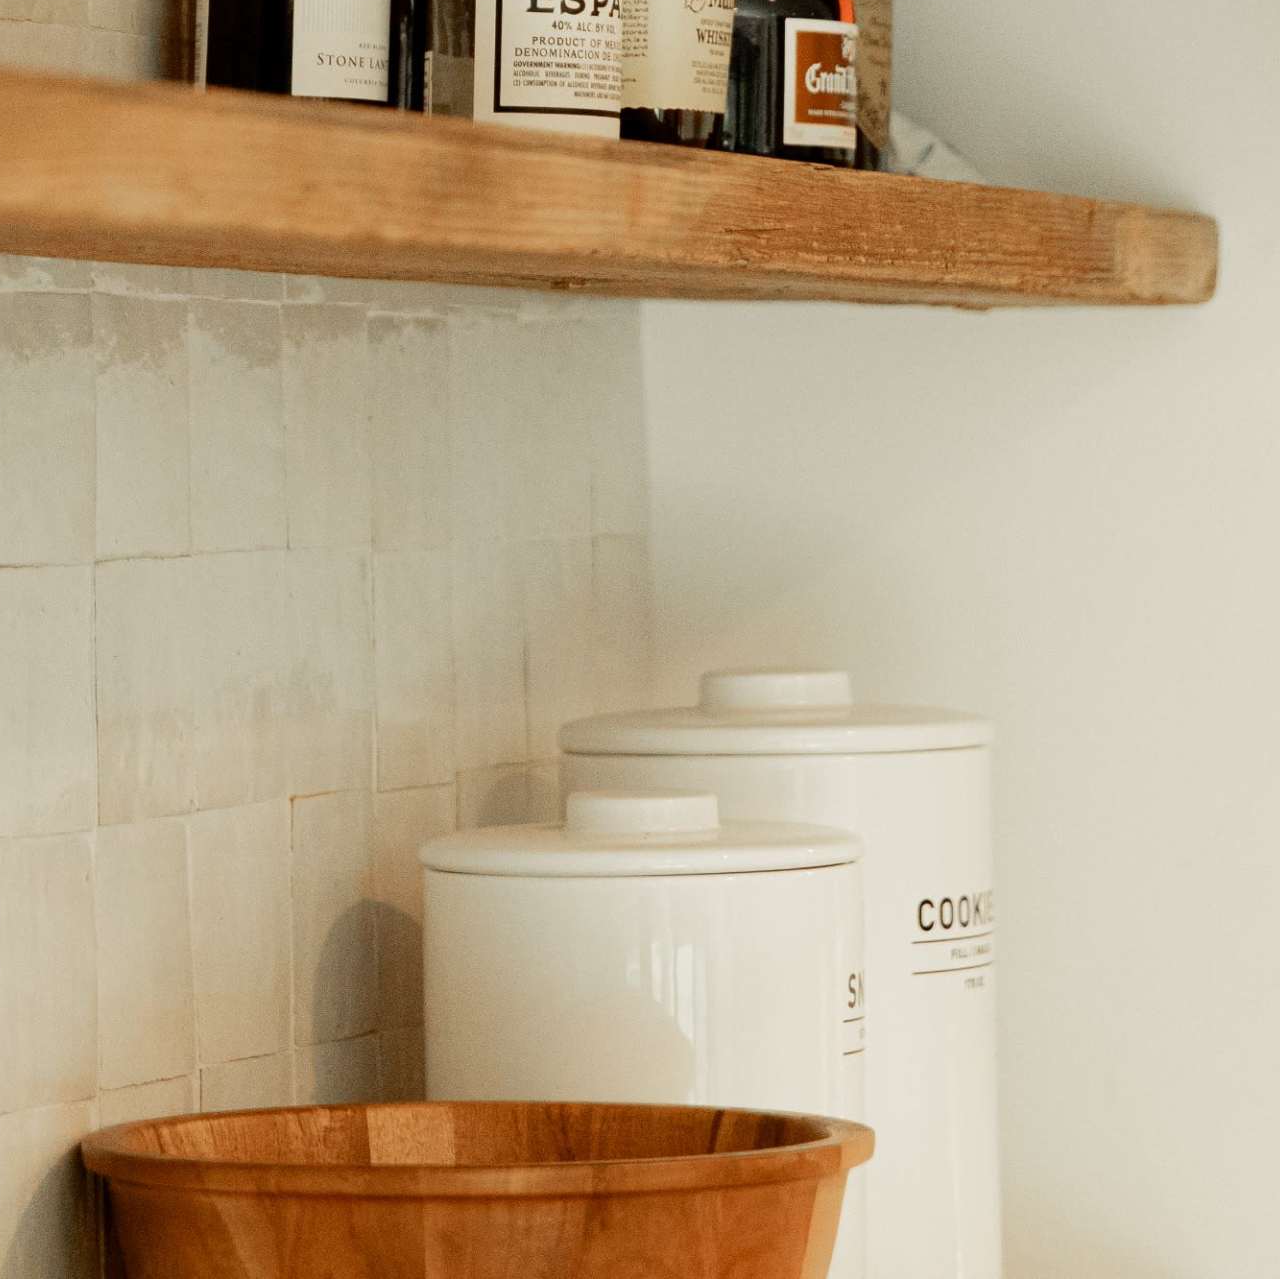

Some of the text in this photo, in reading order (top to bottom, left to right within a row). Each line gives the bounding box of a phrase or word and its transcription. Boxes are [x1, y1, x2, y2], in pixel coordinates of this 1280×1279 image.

[532, 35, 586, 48] PRODUCT
[514, 47, 600, 60] DENOMINACION
[317, 53, 365, 68] STONE
